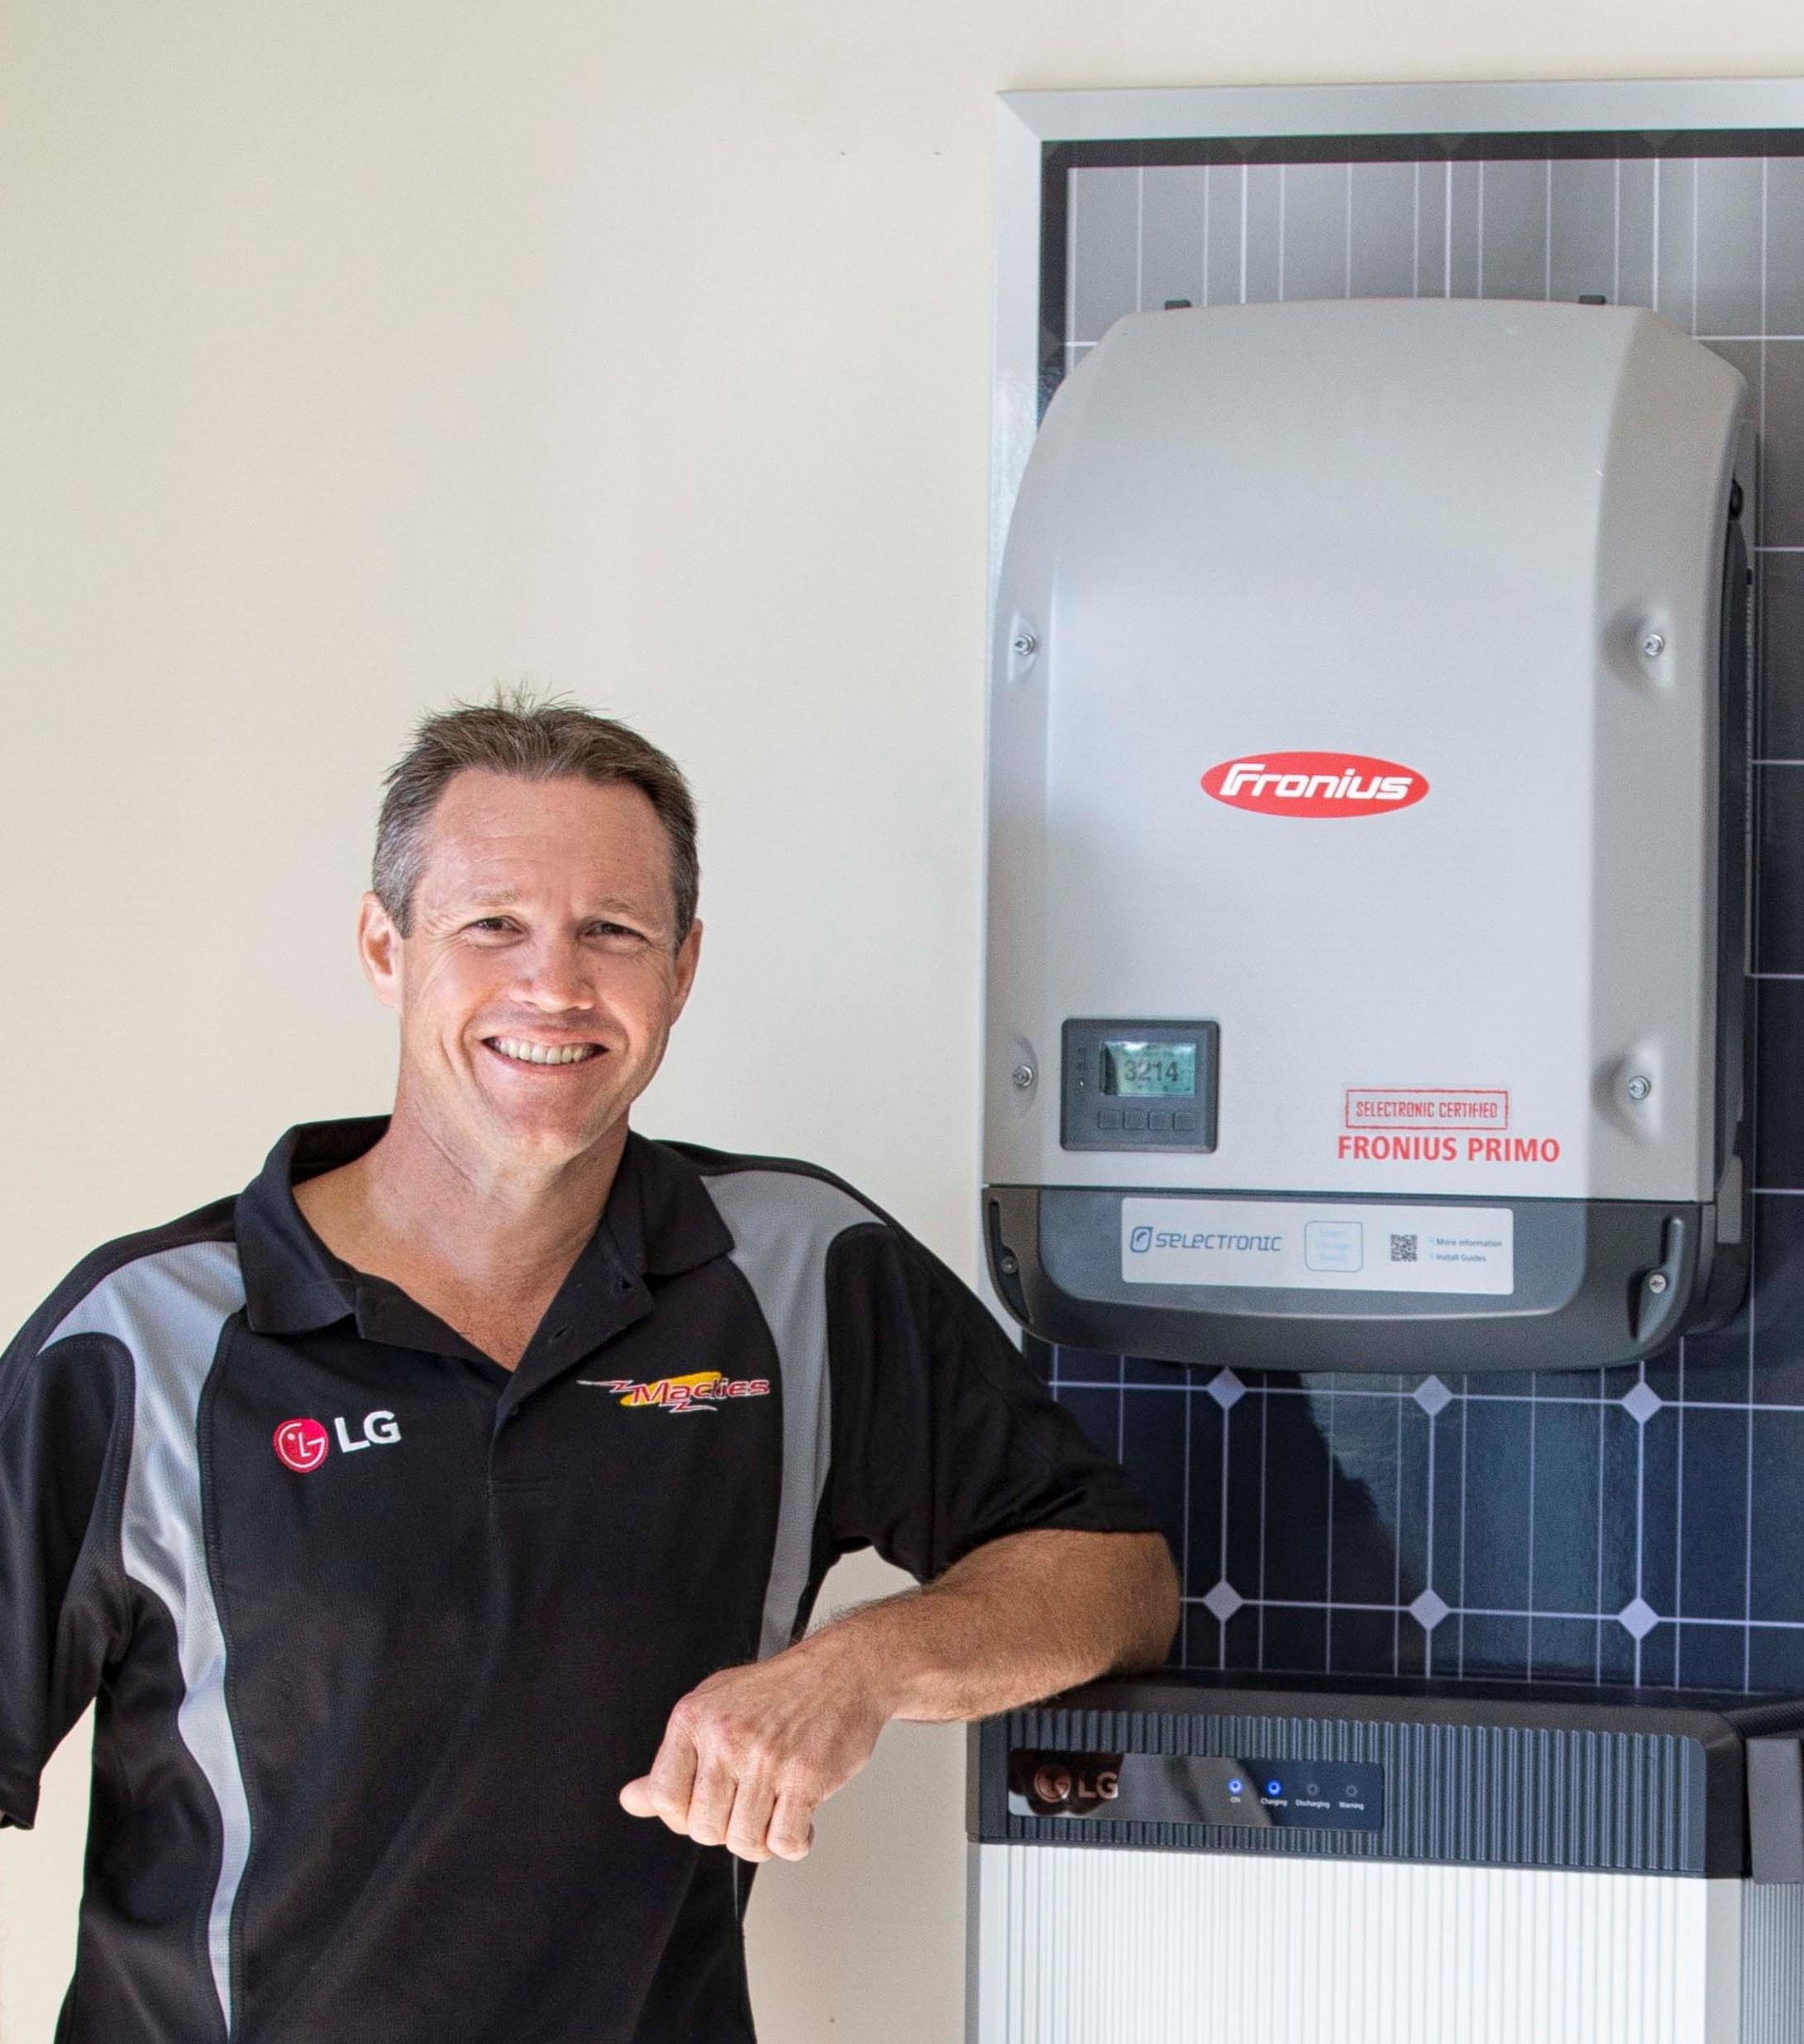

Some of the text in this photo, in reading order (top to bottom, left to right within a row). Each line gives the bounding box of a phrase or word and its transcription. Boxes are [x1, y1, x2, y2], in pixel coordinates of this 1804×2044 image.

[1220, 763, 1413, 800] Fronius
[1125, 1061, 1178, 1082] 3214
[1356, 1101, 1498, 1119] SELECTRONIC CERTIFIED
[1338, 1136, 1561, 1163] FRONIUS PRIMO
[334, 1410, 401, 1453] LG
[1078, 1772, 1119, 1800] LG
[1260, 1796, 1288, 1808] Charging
[1295, 1798, 1330, 1810] Discharging
[1338, 1801, 1364, 1811] Warning
